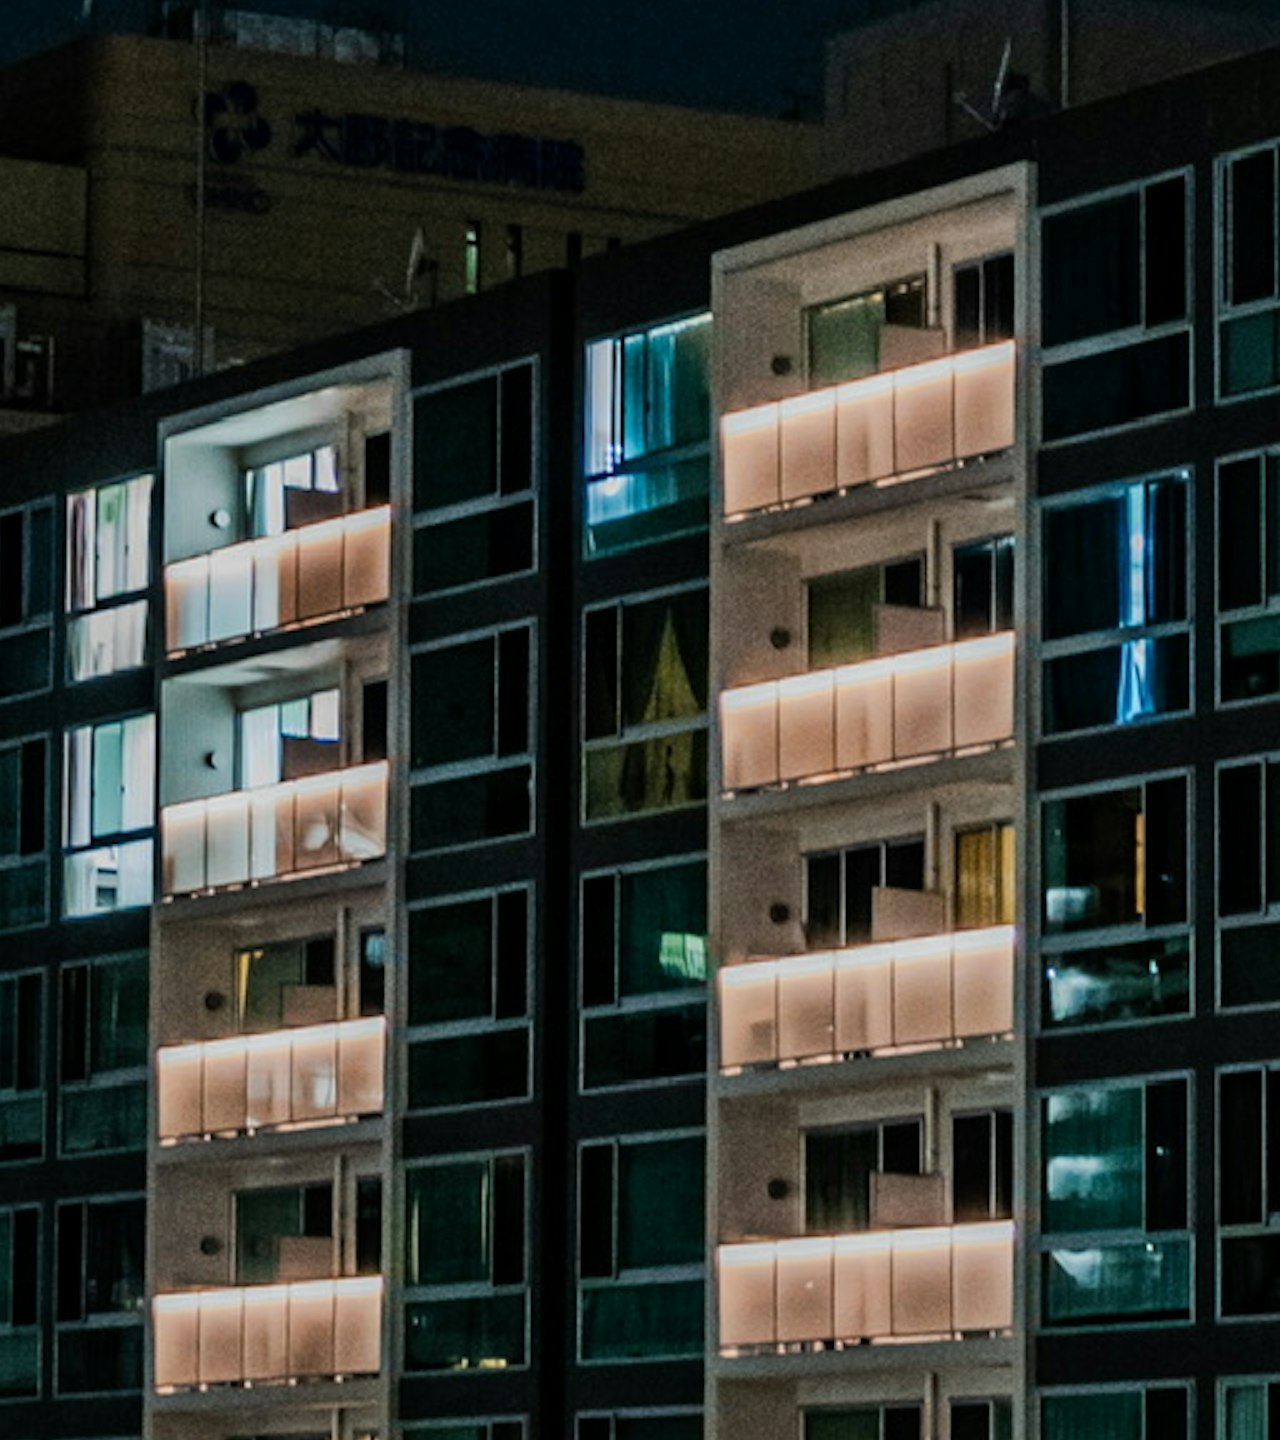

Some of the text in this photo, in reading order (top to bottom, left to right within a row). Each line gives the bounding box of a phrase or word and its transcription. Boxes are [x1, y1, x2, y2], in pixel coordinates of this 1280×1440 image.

[293, 108, 587, 192] 大野記念病院
